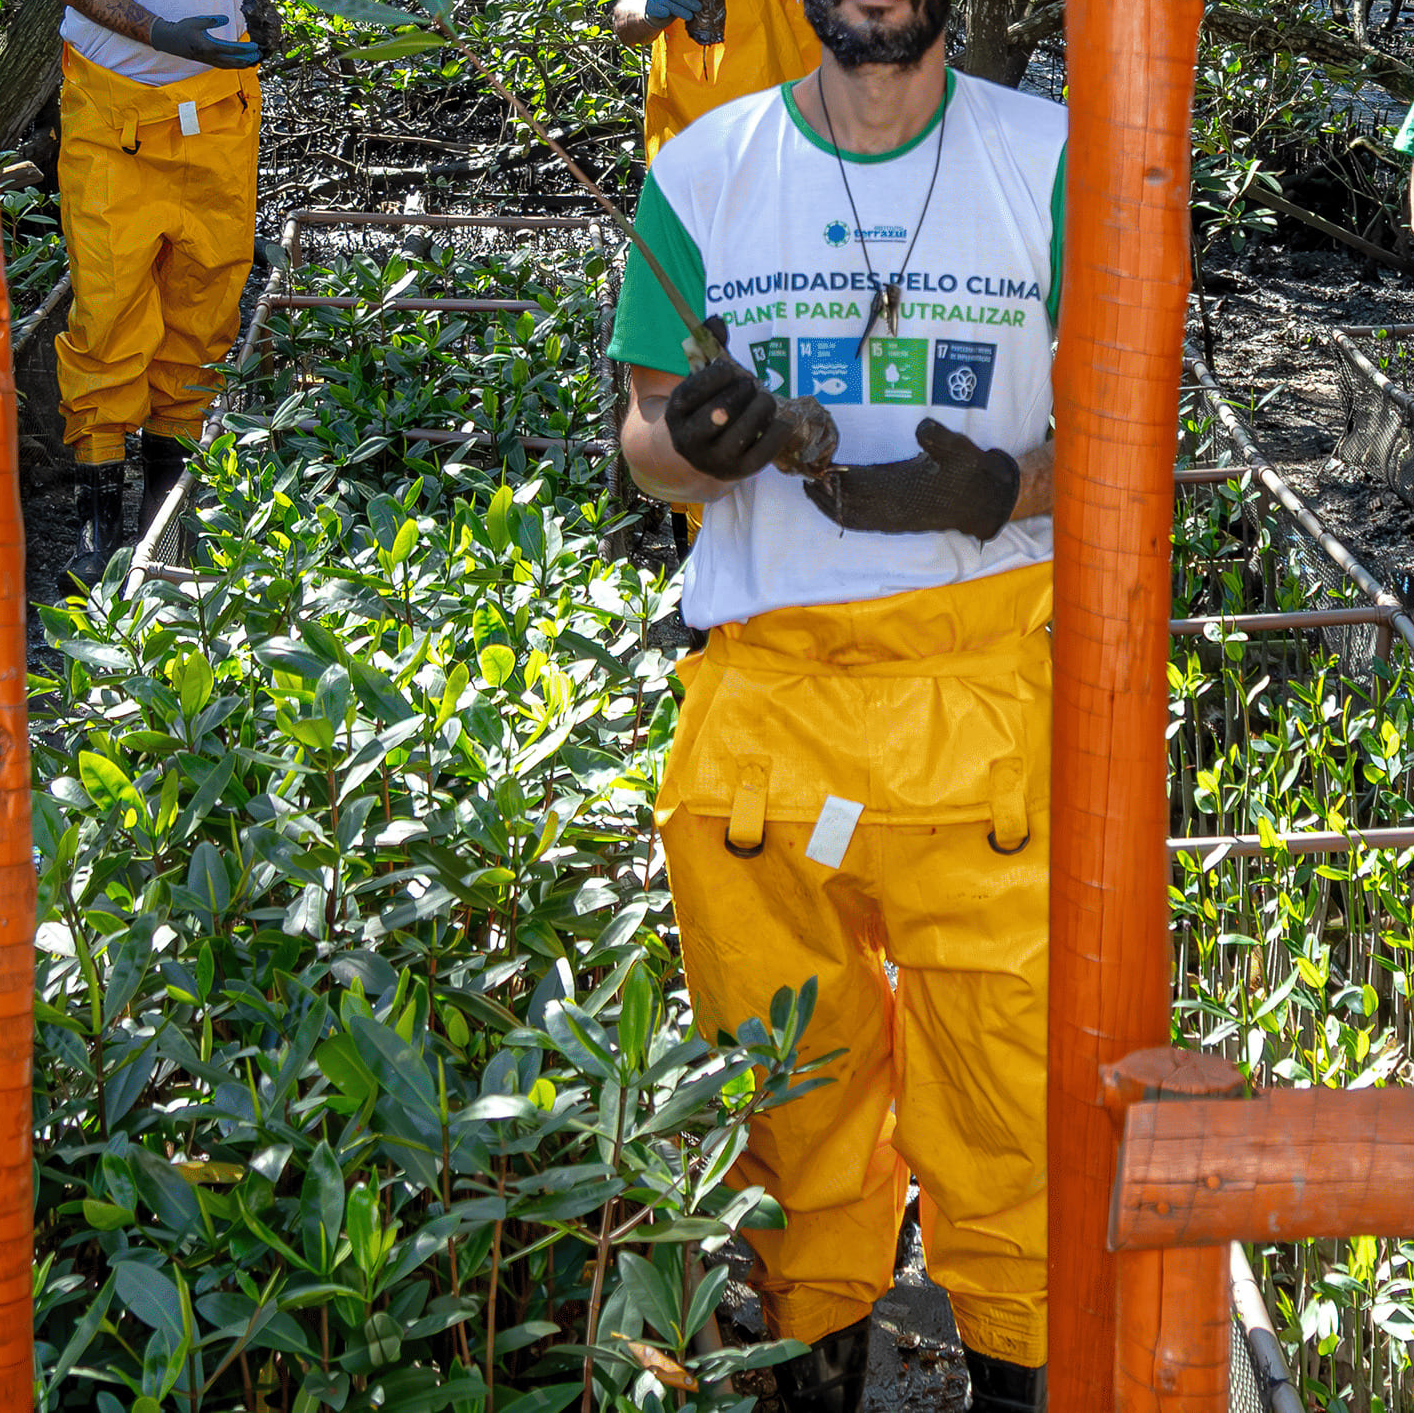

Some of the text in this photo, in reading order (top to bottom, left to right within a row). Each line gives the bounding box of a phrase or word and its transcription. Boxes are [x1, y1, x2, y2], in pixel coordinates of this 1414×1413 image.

[854, 228, 907, 238] terrazul
[707, 272, 1042, 304] COMUNIDADES PELO CLIMA
[795, 302, 862, 319] PARA
[877, 301, 1026, 328] UTRALIZAR
[800, 342, 812, 357] 14
[872, 342, 883, 357] 15
[937, 344, 948, 359] 17
